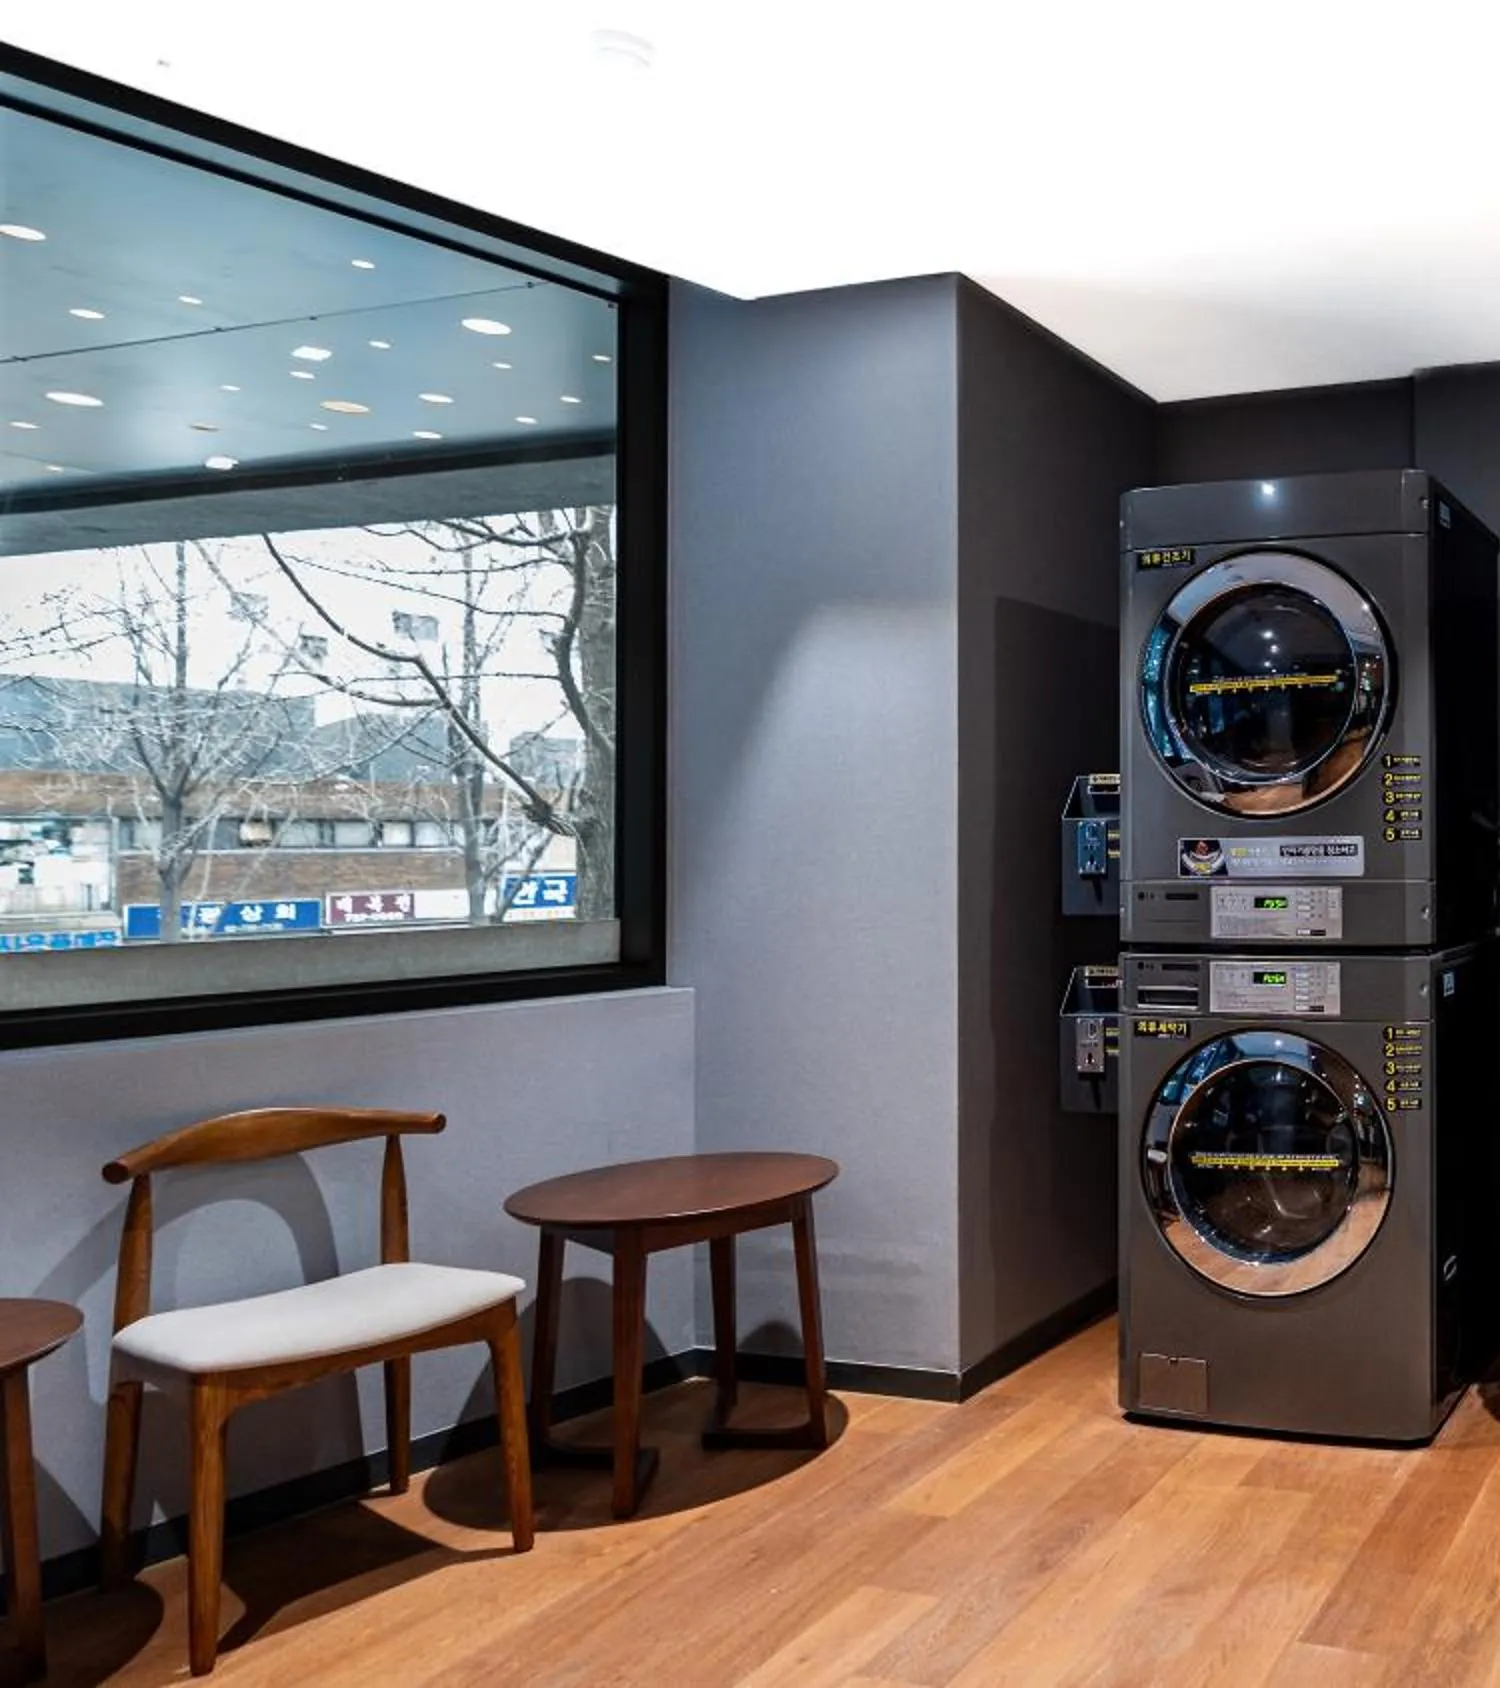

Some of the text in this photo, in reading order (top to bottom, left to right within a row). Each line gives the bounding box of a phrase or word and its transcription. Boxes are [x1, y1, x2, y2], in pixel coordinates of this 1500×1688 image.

[1384, 773, 1393, 786] 2
[1385, 791, 1394, 803] 3
[1385, 809, 1394, 821] 4
[1385, 828, 1395, 841] 5
[1385, 1043, 1395, 1057] 2
[1385, 1061, 1395, 1075] 3
[1386, 1080, 1395, 1092] 4
[1387, 1097, 1396, 1111] 5
